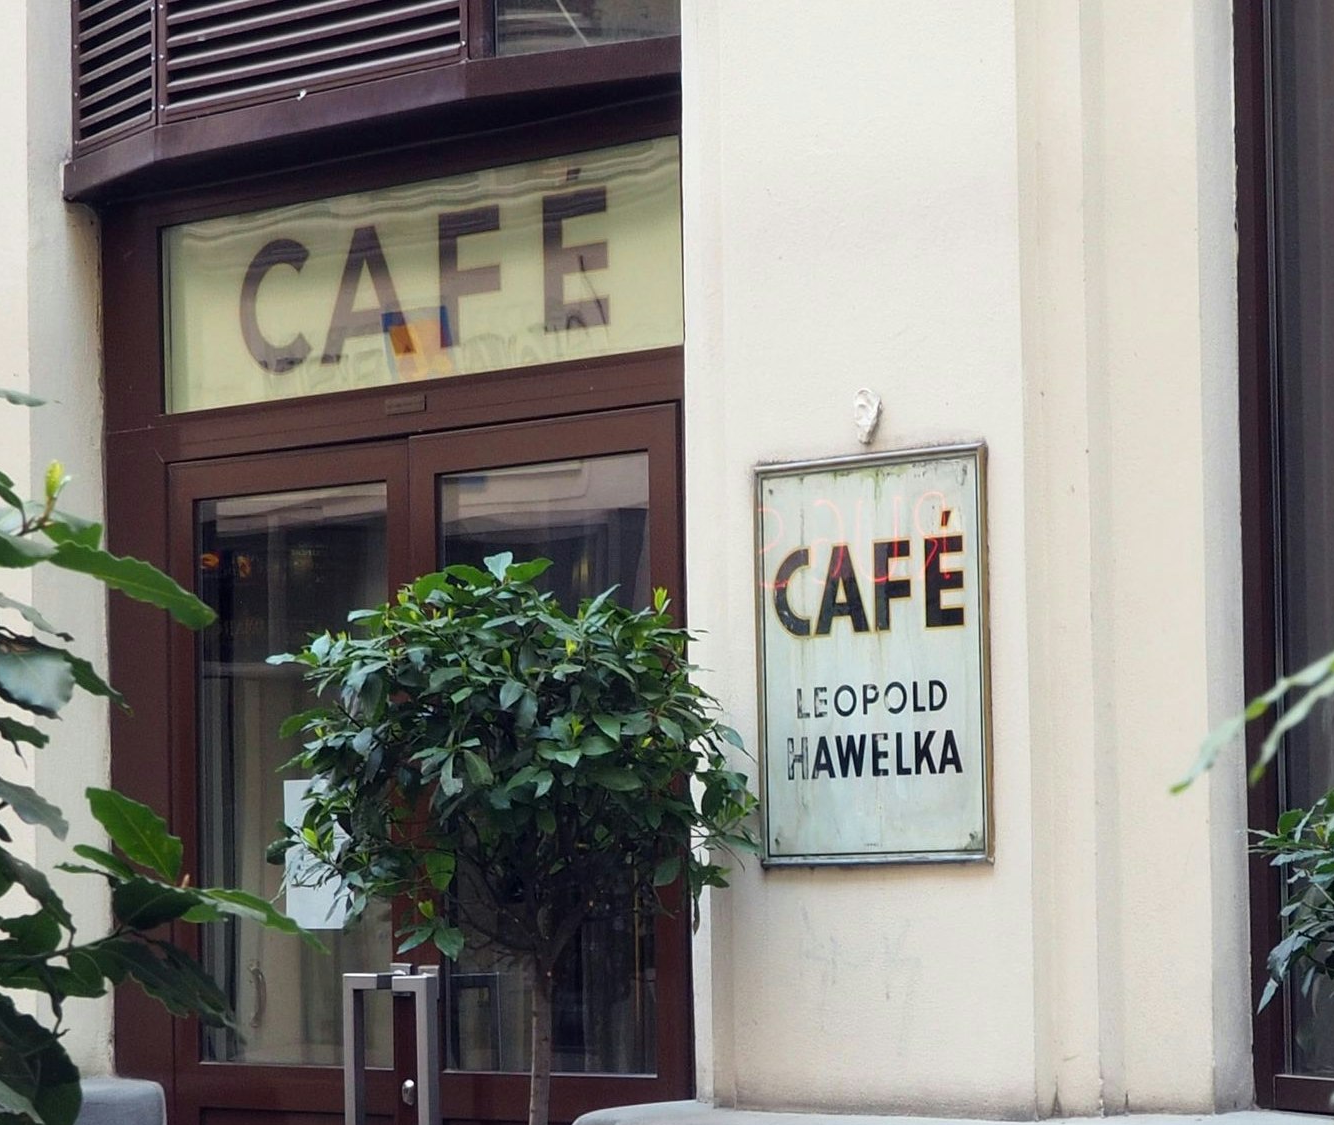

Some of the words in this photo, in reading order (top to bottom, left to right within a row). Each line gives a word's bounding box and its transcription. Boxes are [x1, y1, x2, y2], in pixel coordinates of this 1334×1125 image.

[240, 169, 610, 373] CAFÉ
[773, 510, 964, 637] CAFÉ
[796, 680, 948, 720] LEOPOLD
[787, 729, 964, 780] HAWELKA
